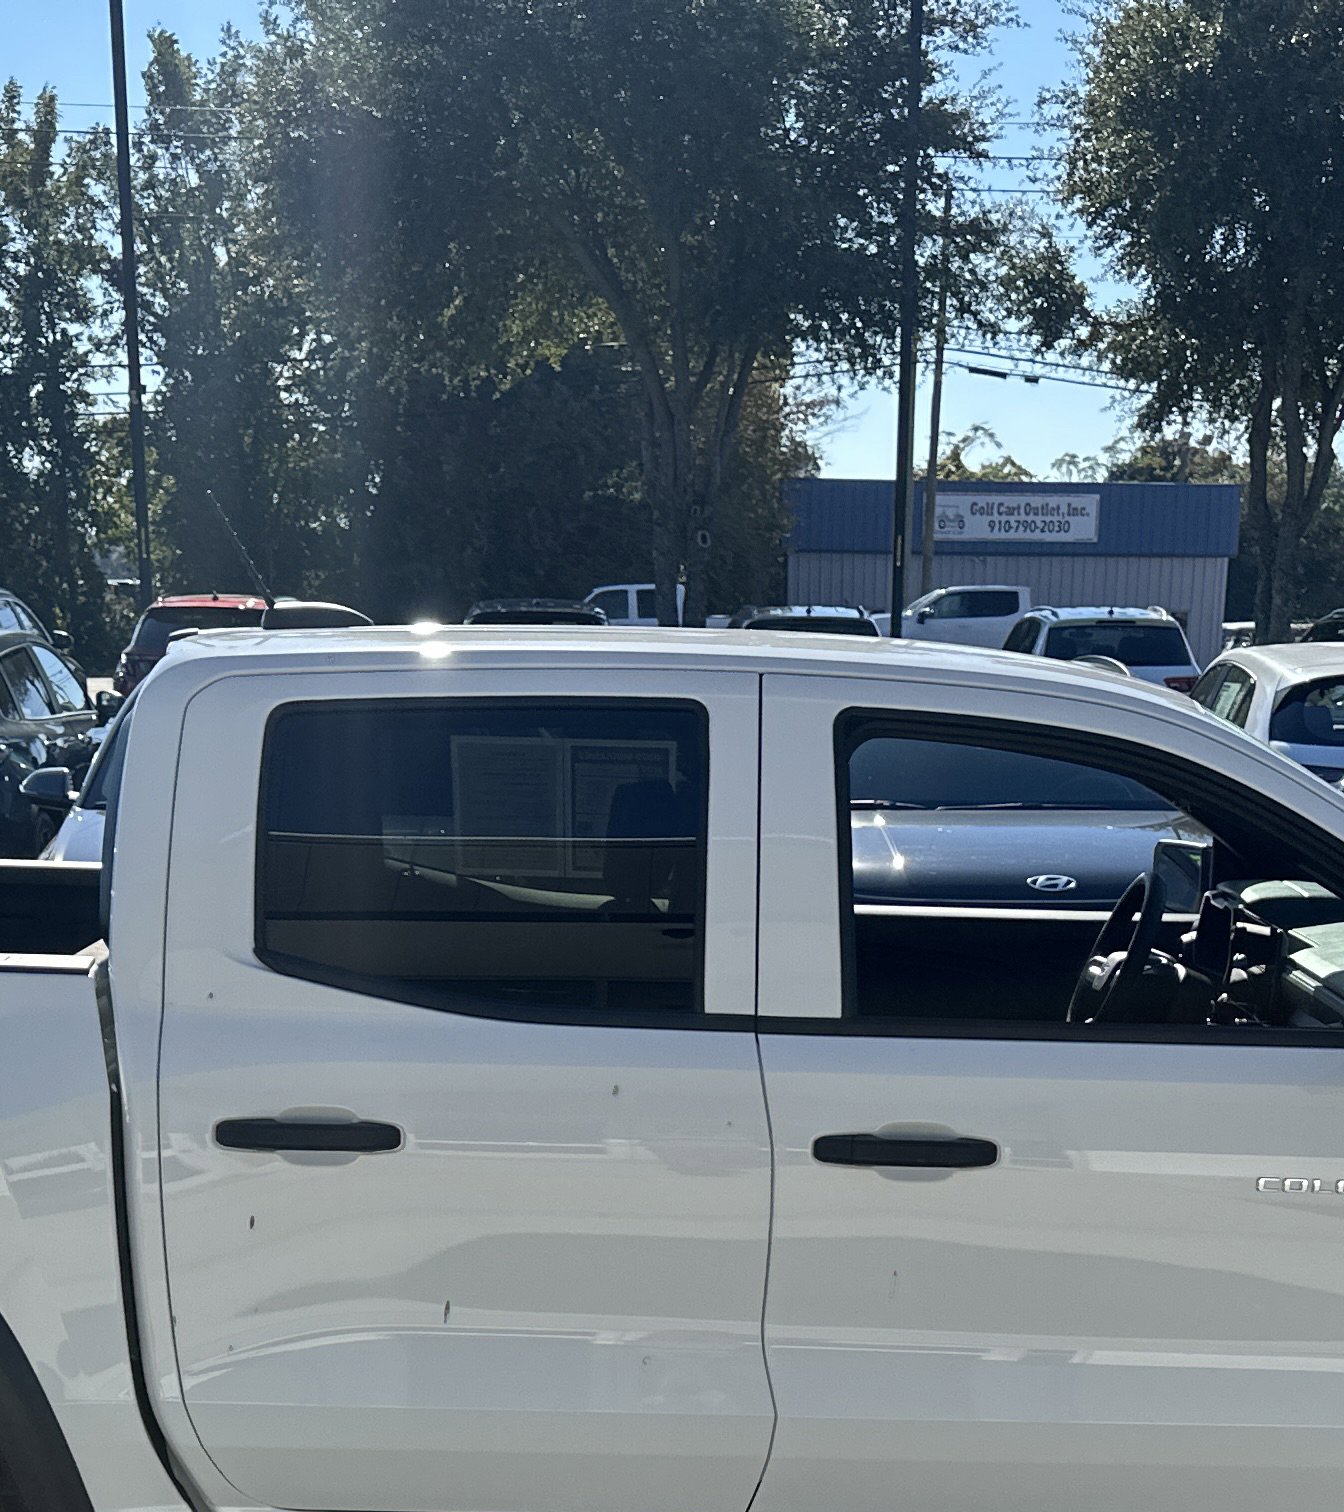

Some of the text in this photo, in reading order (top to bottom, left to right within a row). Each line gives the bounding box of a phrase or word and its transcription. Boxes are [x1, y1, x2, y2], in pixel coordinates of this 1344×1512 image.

[970, 502, 1090, 519] Golf Cart Outlet, Inc.
[988, 520, 1071, 533] 910-790-2030
